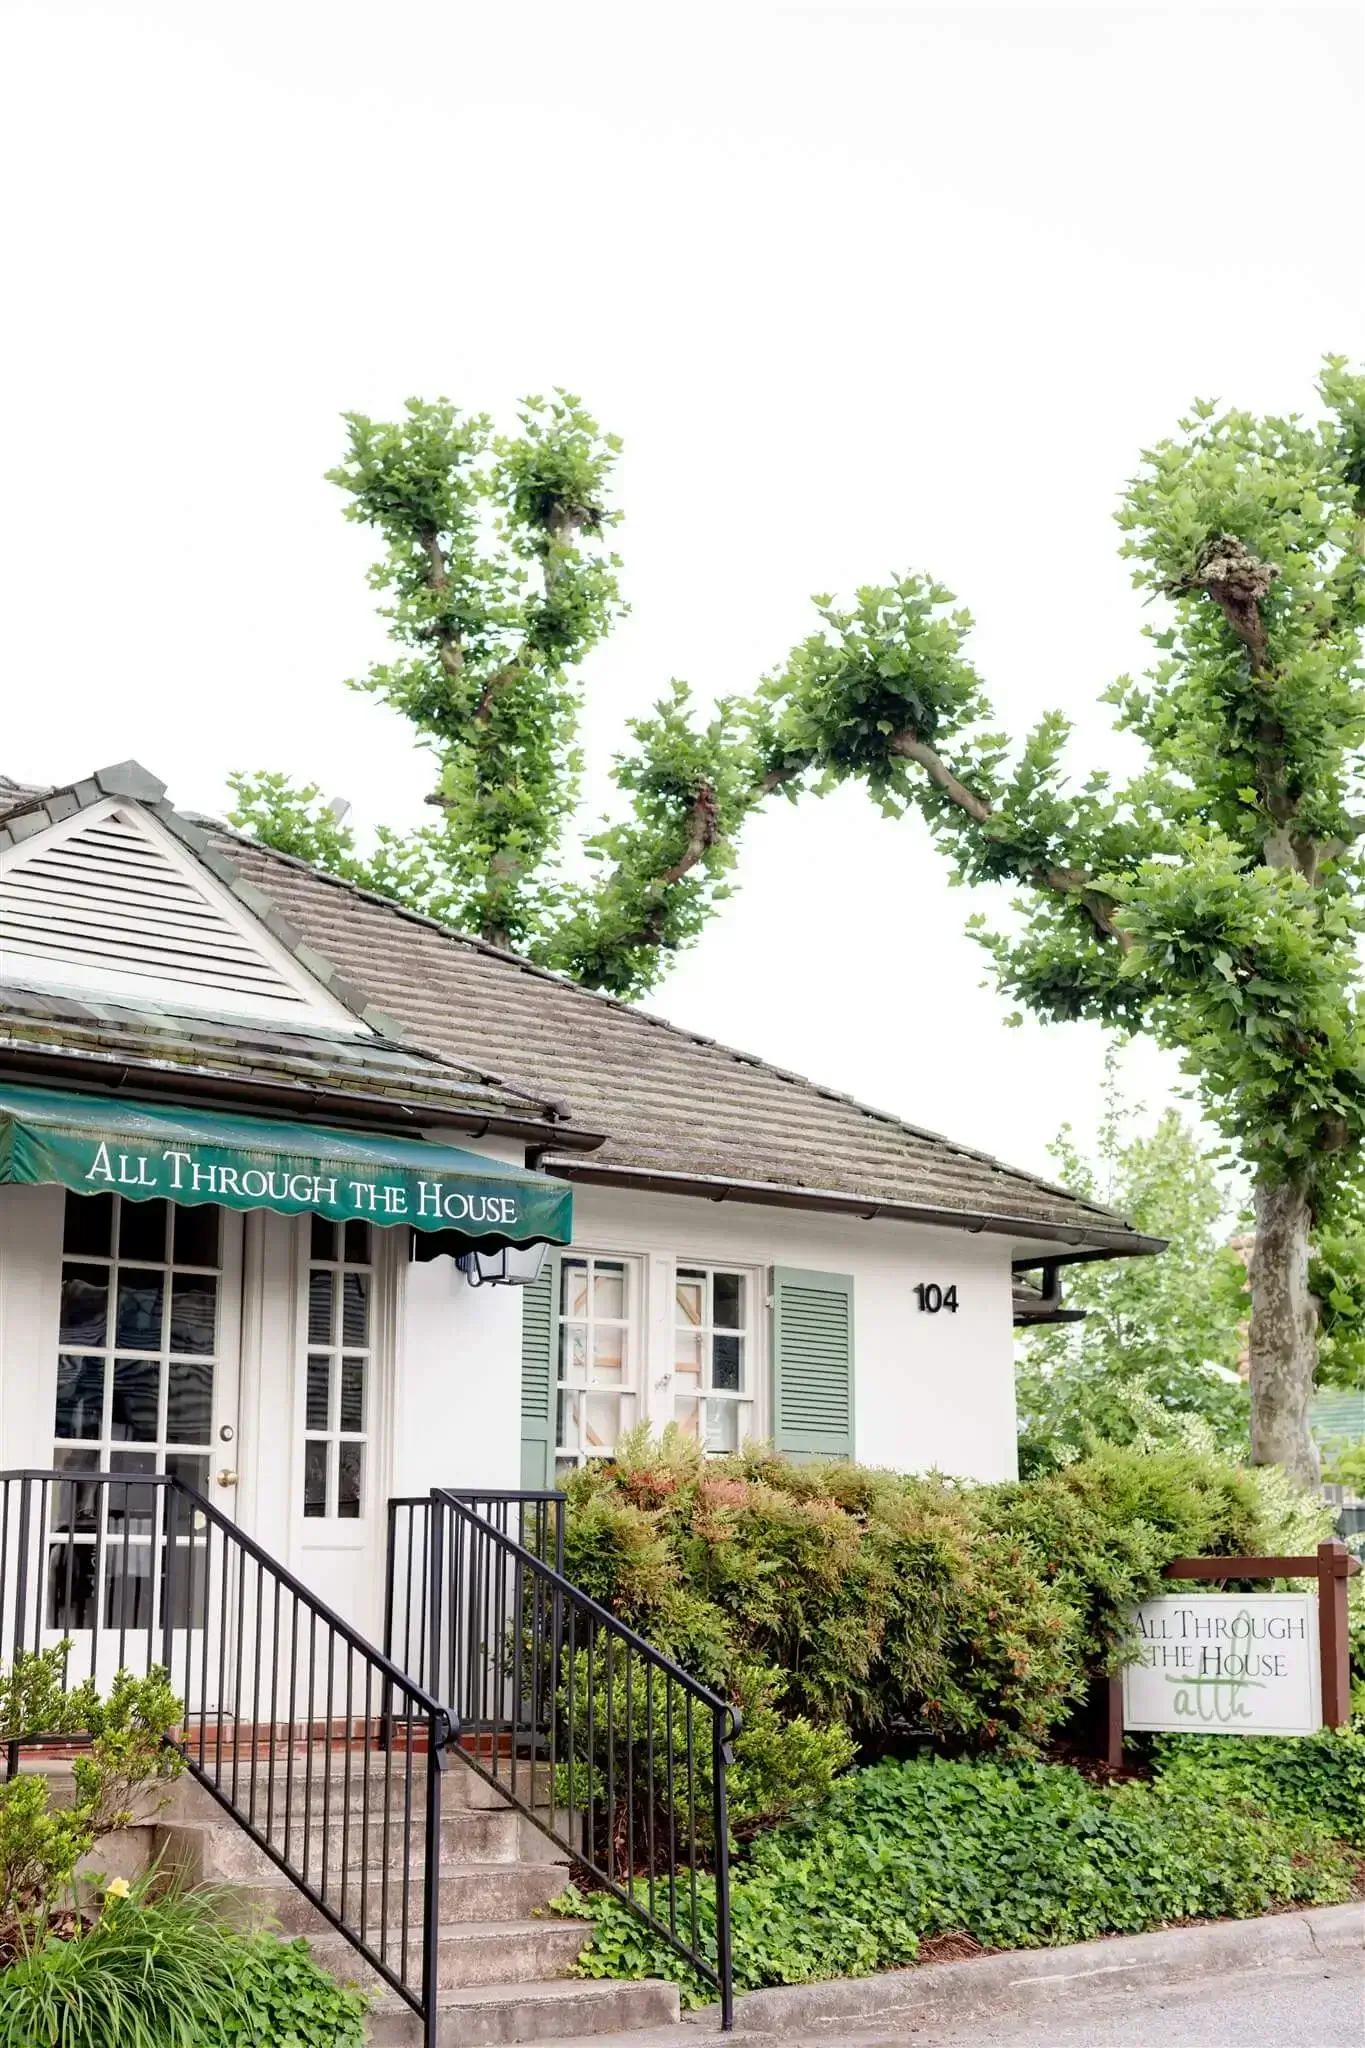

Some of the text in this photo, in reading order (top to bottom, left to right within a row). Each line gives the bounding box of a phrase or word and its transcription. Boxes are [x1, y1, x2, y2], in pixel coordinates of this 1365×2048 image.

[85, 1142, 518, 1224] ALL THROUGH THE HOUSE
[912, 1283, 959, 1313] 104
[1134, 1610, 1304, 1639] ALL THROUGH
[1200, 1646, 1288, 1677] HOUSE
